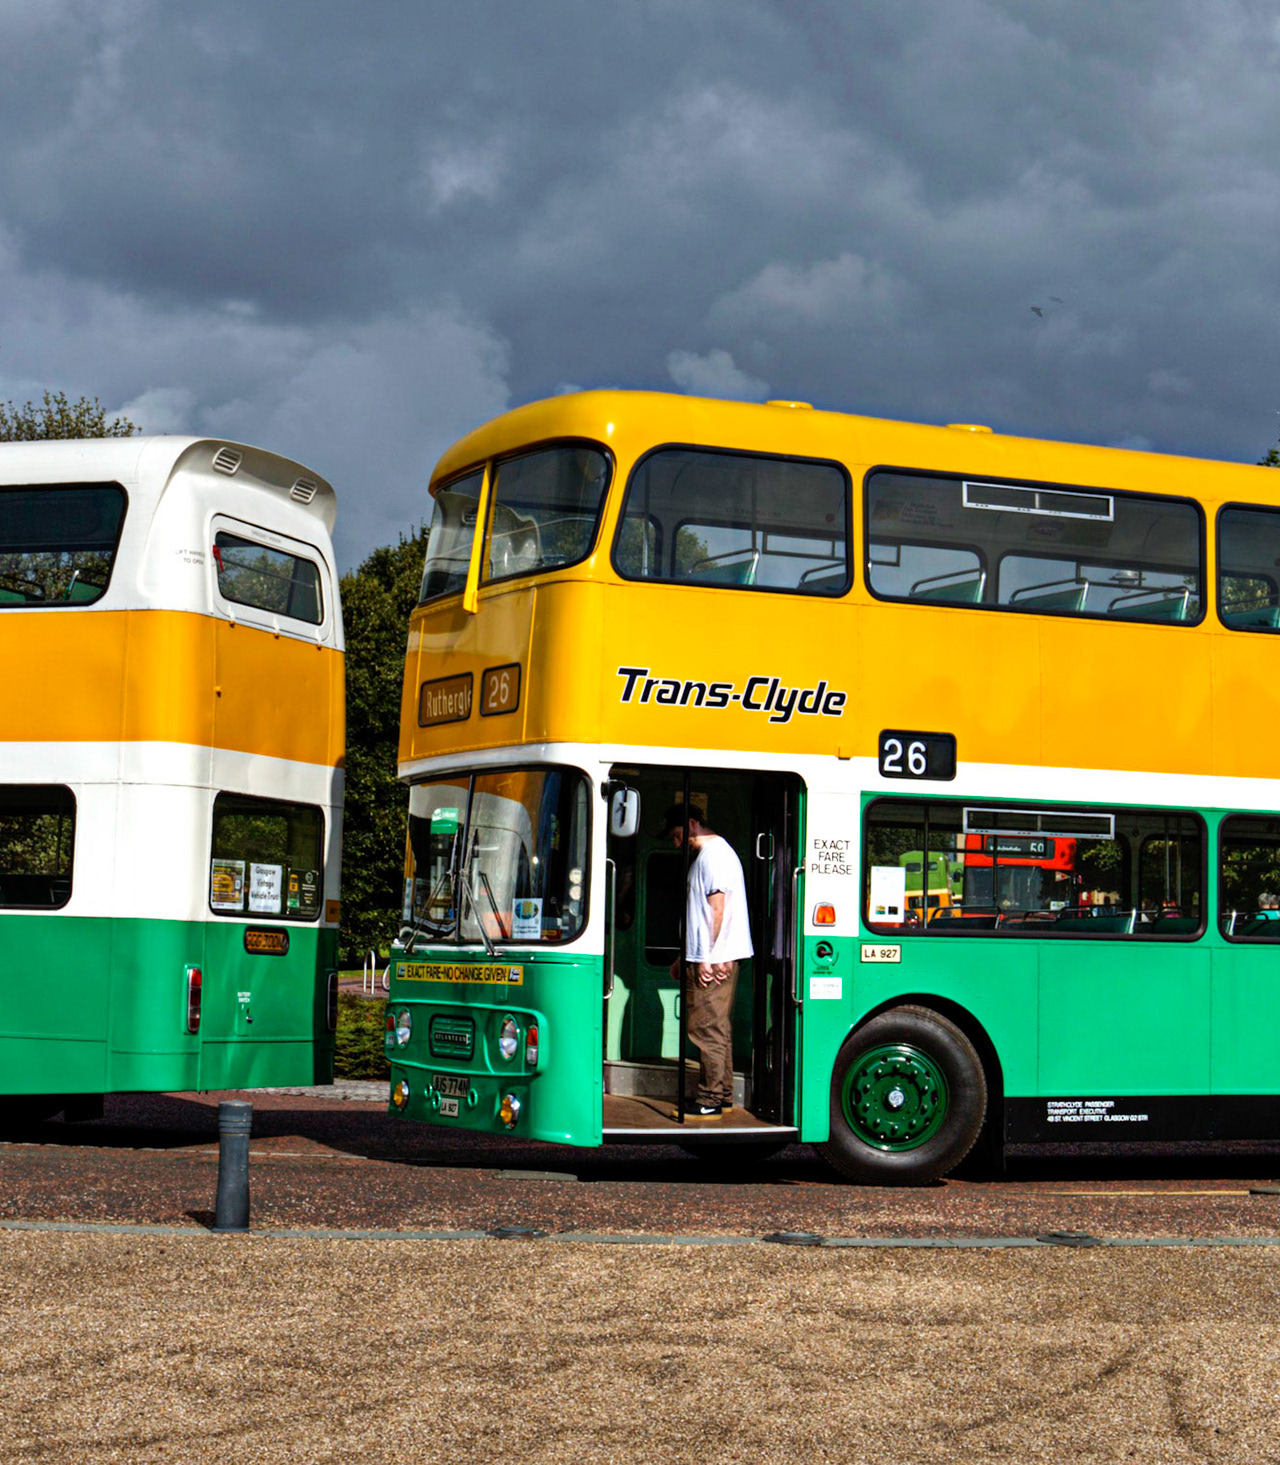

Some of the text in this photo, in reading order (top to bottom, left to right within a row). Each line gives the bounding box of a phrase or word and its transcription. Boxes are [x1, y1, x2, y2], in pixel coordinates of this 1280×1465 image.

[488, 671, 510, 708] 26
[618, 667, 847, 723] Trans-Clyde
[883, 739, 926, 775] 26
[813, 839, 850, 850] EXACT
[818, 852, 845, 863] FARE
[256, 866, 276, 876] Glasgow
[811, 863, 853, 875] PLEASE
[257, 880, 274, 889] Vintage
[251, 890, 267, 900] Vehicle
[864, 949, 897, 958] LA 927
[407, 965, 425, 978] EXACT
[455, 966, 482, 980] CHANGE
